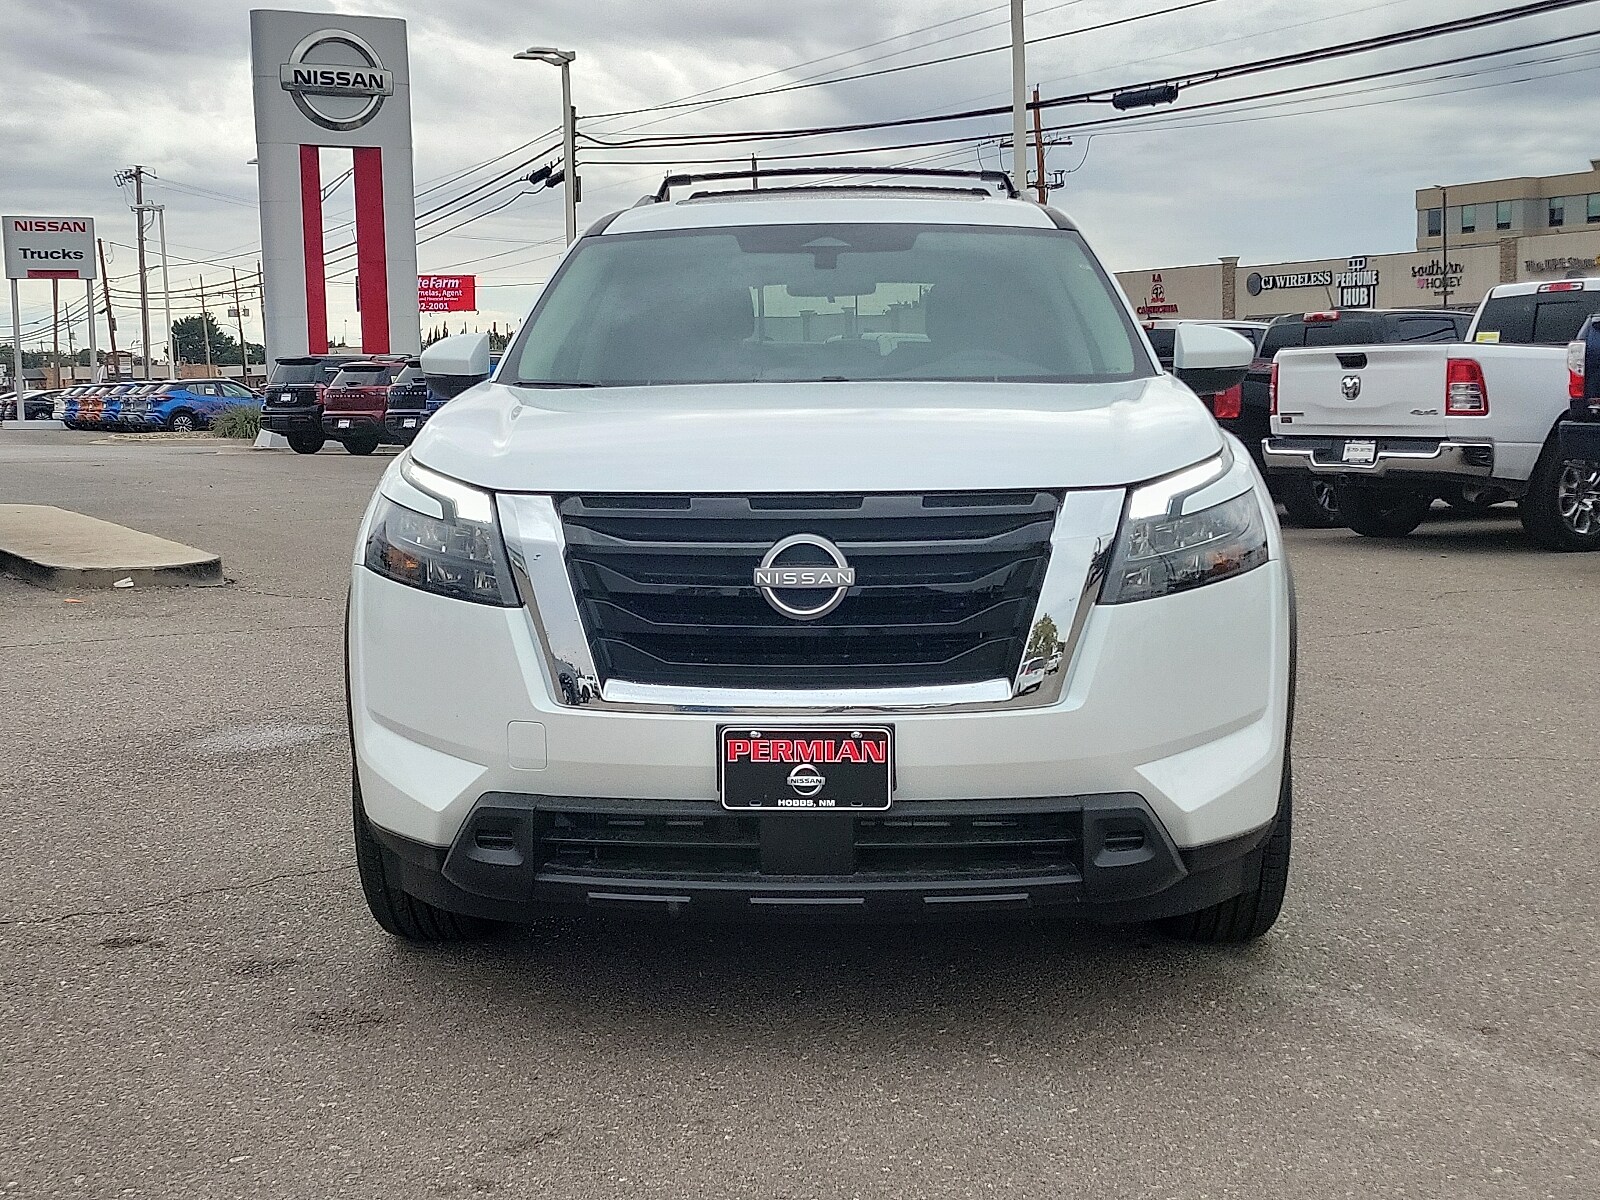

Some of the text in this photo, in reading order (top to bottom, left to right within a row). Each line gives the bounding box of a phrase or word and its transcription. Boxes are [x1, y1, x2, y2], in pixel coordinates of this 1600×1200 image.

[293, 69, 385, 89] NISSAN
[14, 220, 87, 233] NISSAN
[18, 247, 85, 260] Trucks
[1260, 270, 1332, 290] CJ WIRELESS
[1335, 270, 1378, 287] PERFUME
[1343, 286, 1370, 306] HUB
[756, 572, 852, 585] NISSAN
[726, 739, 887, 764] PERMIAN
[790, 777, 823, 785] NISSAN
[777, 799, 836, 808] HOBBS, NM
